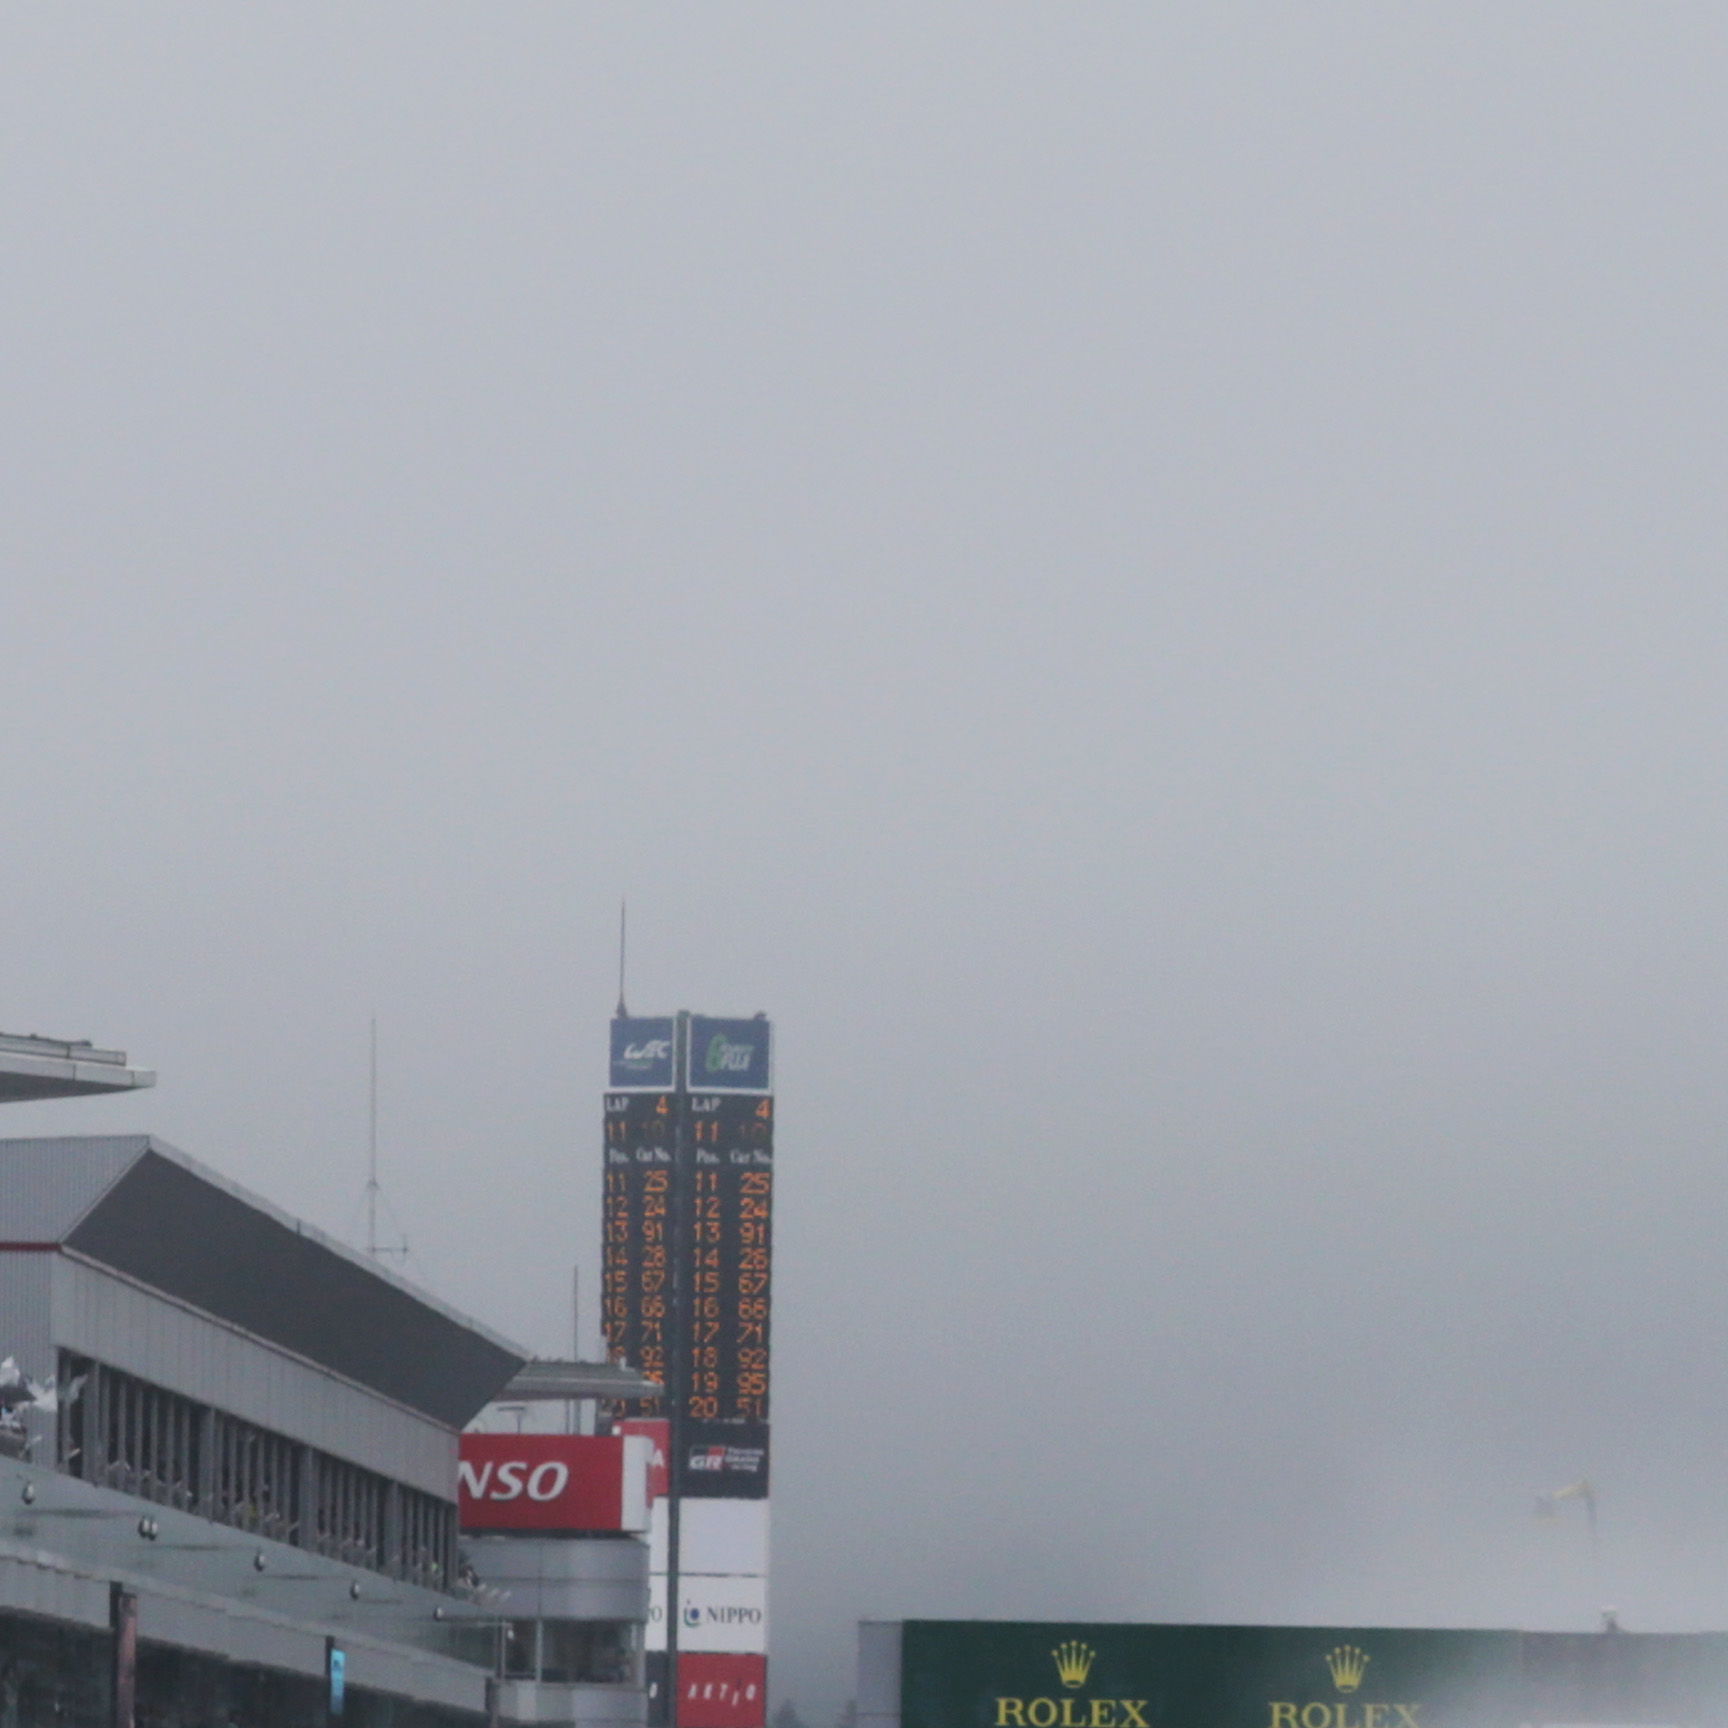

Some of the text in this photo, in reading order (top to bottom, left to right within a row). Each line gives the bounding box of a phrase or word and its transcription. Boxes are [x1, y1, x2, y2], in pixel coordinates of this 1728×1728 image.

[606, 1095, 669, 1115] LAP 4
[691, 1096, 770, 1119] LAP 4
[696, 1171, 770, 1194] 11 25
[695, 1196, 768, 1219] 12 24
[694, 1221, 766, 1245] 13 91
[695, 1247, 720, 1267] 14
[694, 1271, 768, 1294] 15 67
[738, 1297, 768, 1319] 66
[692, 1321, 764, 1343] 17 71
[692, 1346, 767, 1370] 18 92
[689, 1396, 719, 1419] 20
[707, 1606, 762, 1624] NIPPO
[994, 1696, 1151, 1728] ROLEX
